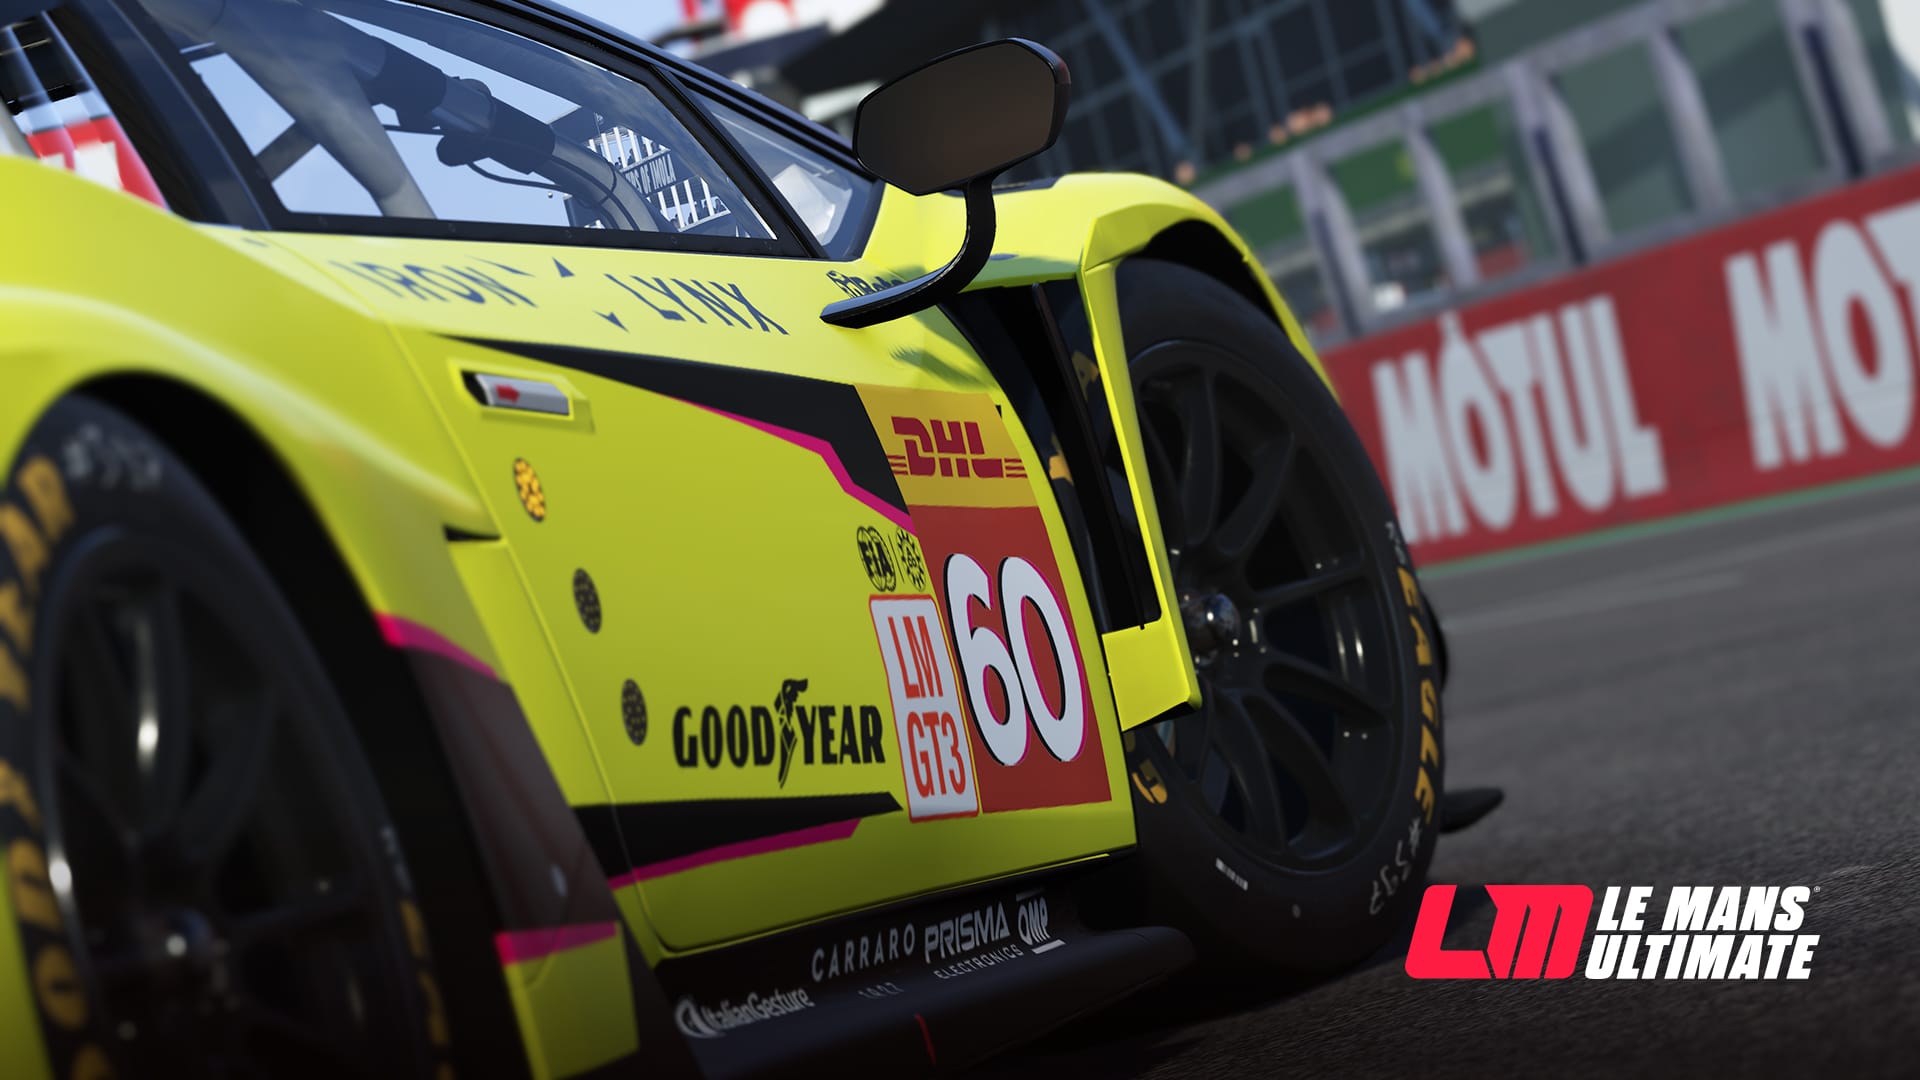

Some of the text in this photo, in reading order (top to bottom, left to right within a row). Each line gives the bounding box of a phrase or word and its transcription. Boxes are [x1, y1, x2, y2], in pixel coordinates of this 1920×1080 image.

[649, 153, 677, 190] IMOLA
[328, 259, 538, 308] IRON
[603, 273, 790, 335] LYNX
[891, 416, 1005, 479] DHL
[1370, 293, 1667, 545] MOTUL
[887, 615, 944, 699] LM
[943, 553, 1088, 767] 60
[1397, 566, 1440, 825] EAGLE
[906, 710, 967, 798] GT3
[811, 923, 916, 983] CARRARO
[924, 901, 1010, 964] PRISMA
[1017, 897, 1051, 946] OMP
[933, 943, 1025, 979] ELECTRONICS
